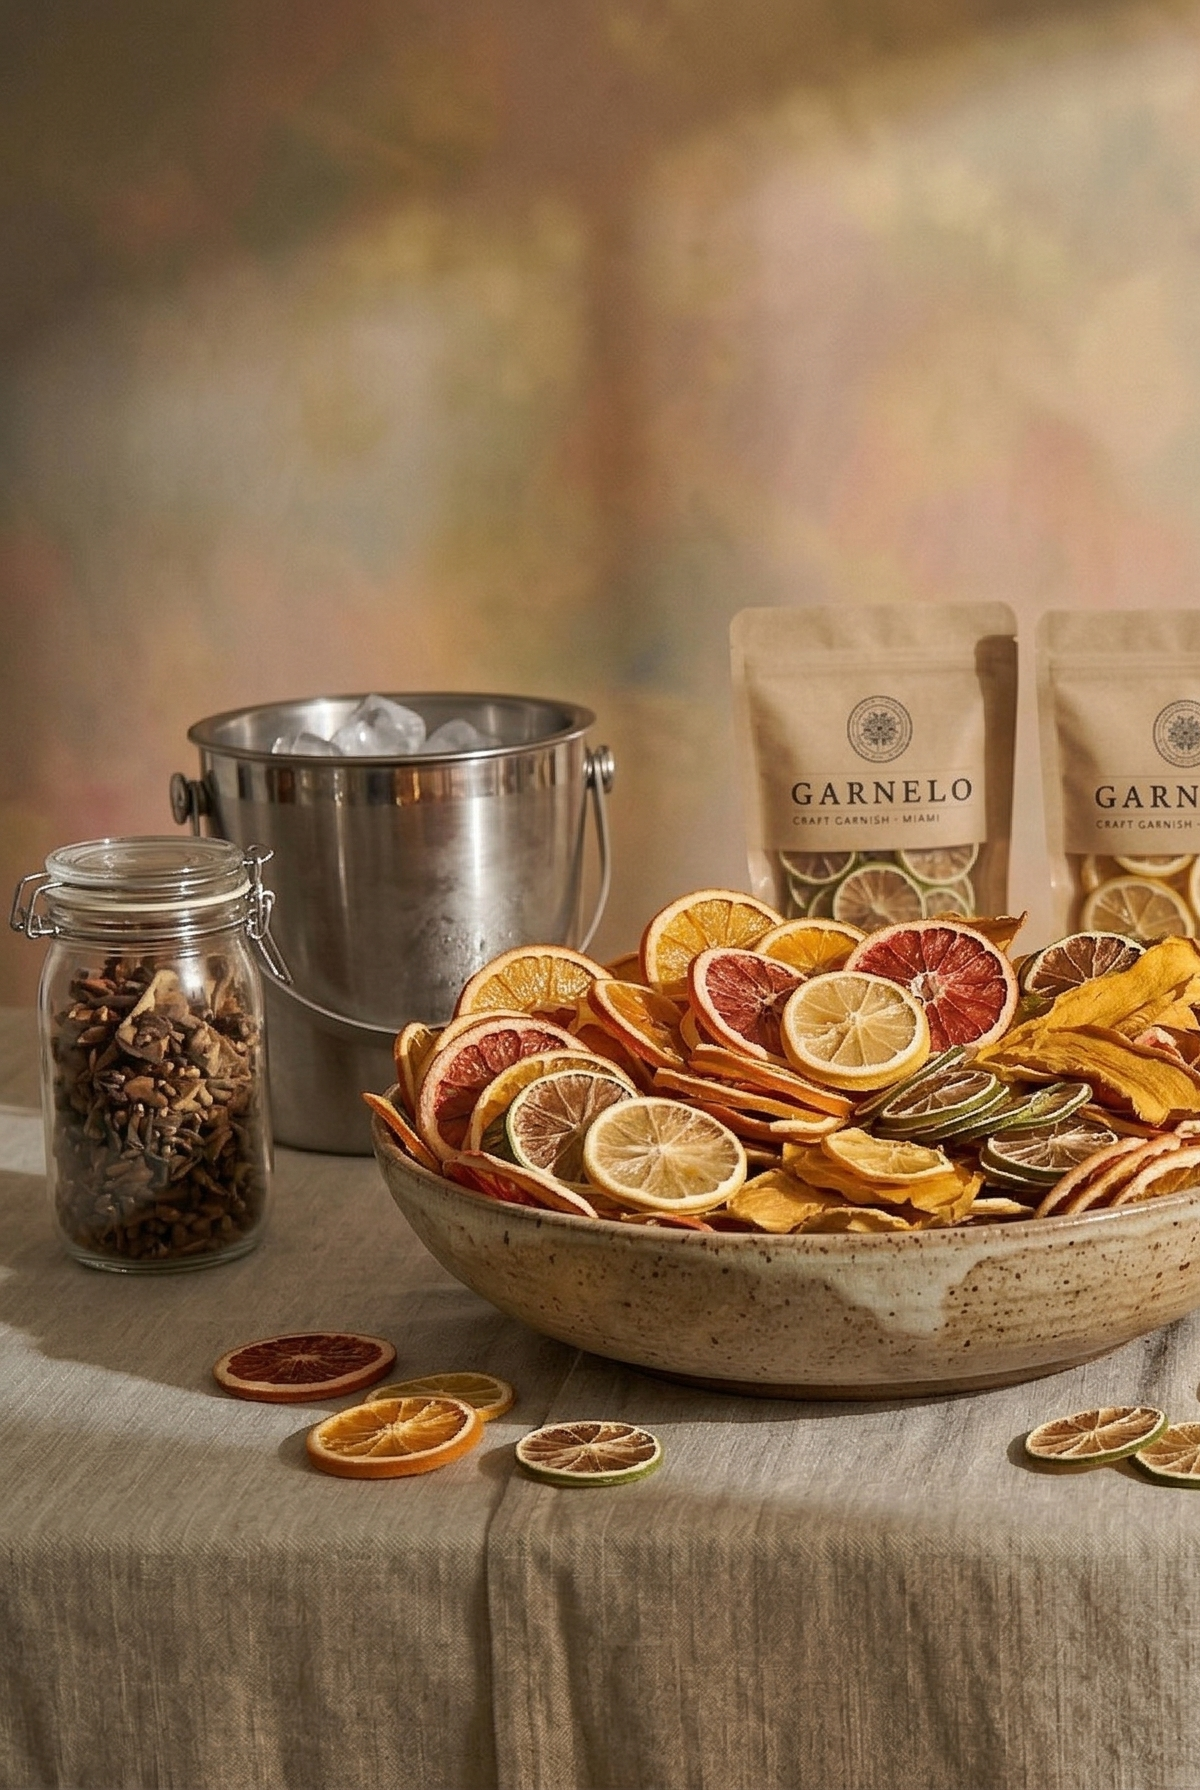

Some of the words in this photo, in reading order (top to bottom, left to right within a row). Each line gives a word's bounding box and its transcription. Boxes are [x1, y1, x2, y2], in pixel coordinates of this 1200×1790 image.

[791, 778, 972, 806] GARNELO
[792, 815, 830, 826] CRAFT
[834, 814, 890, 826] GARNISH
[902, 813, 940, 824] MIAMI
[1095, 819, 1134, 830] CRAFT
[1138, 819, 1193, 830] GARNISH
